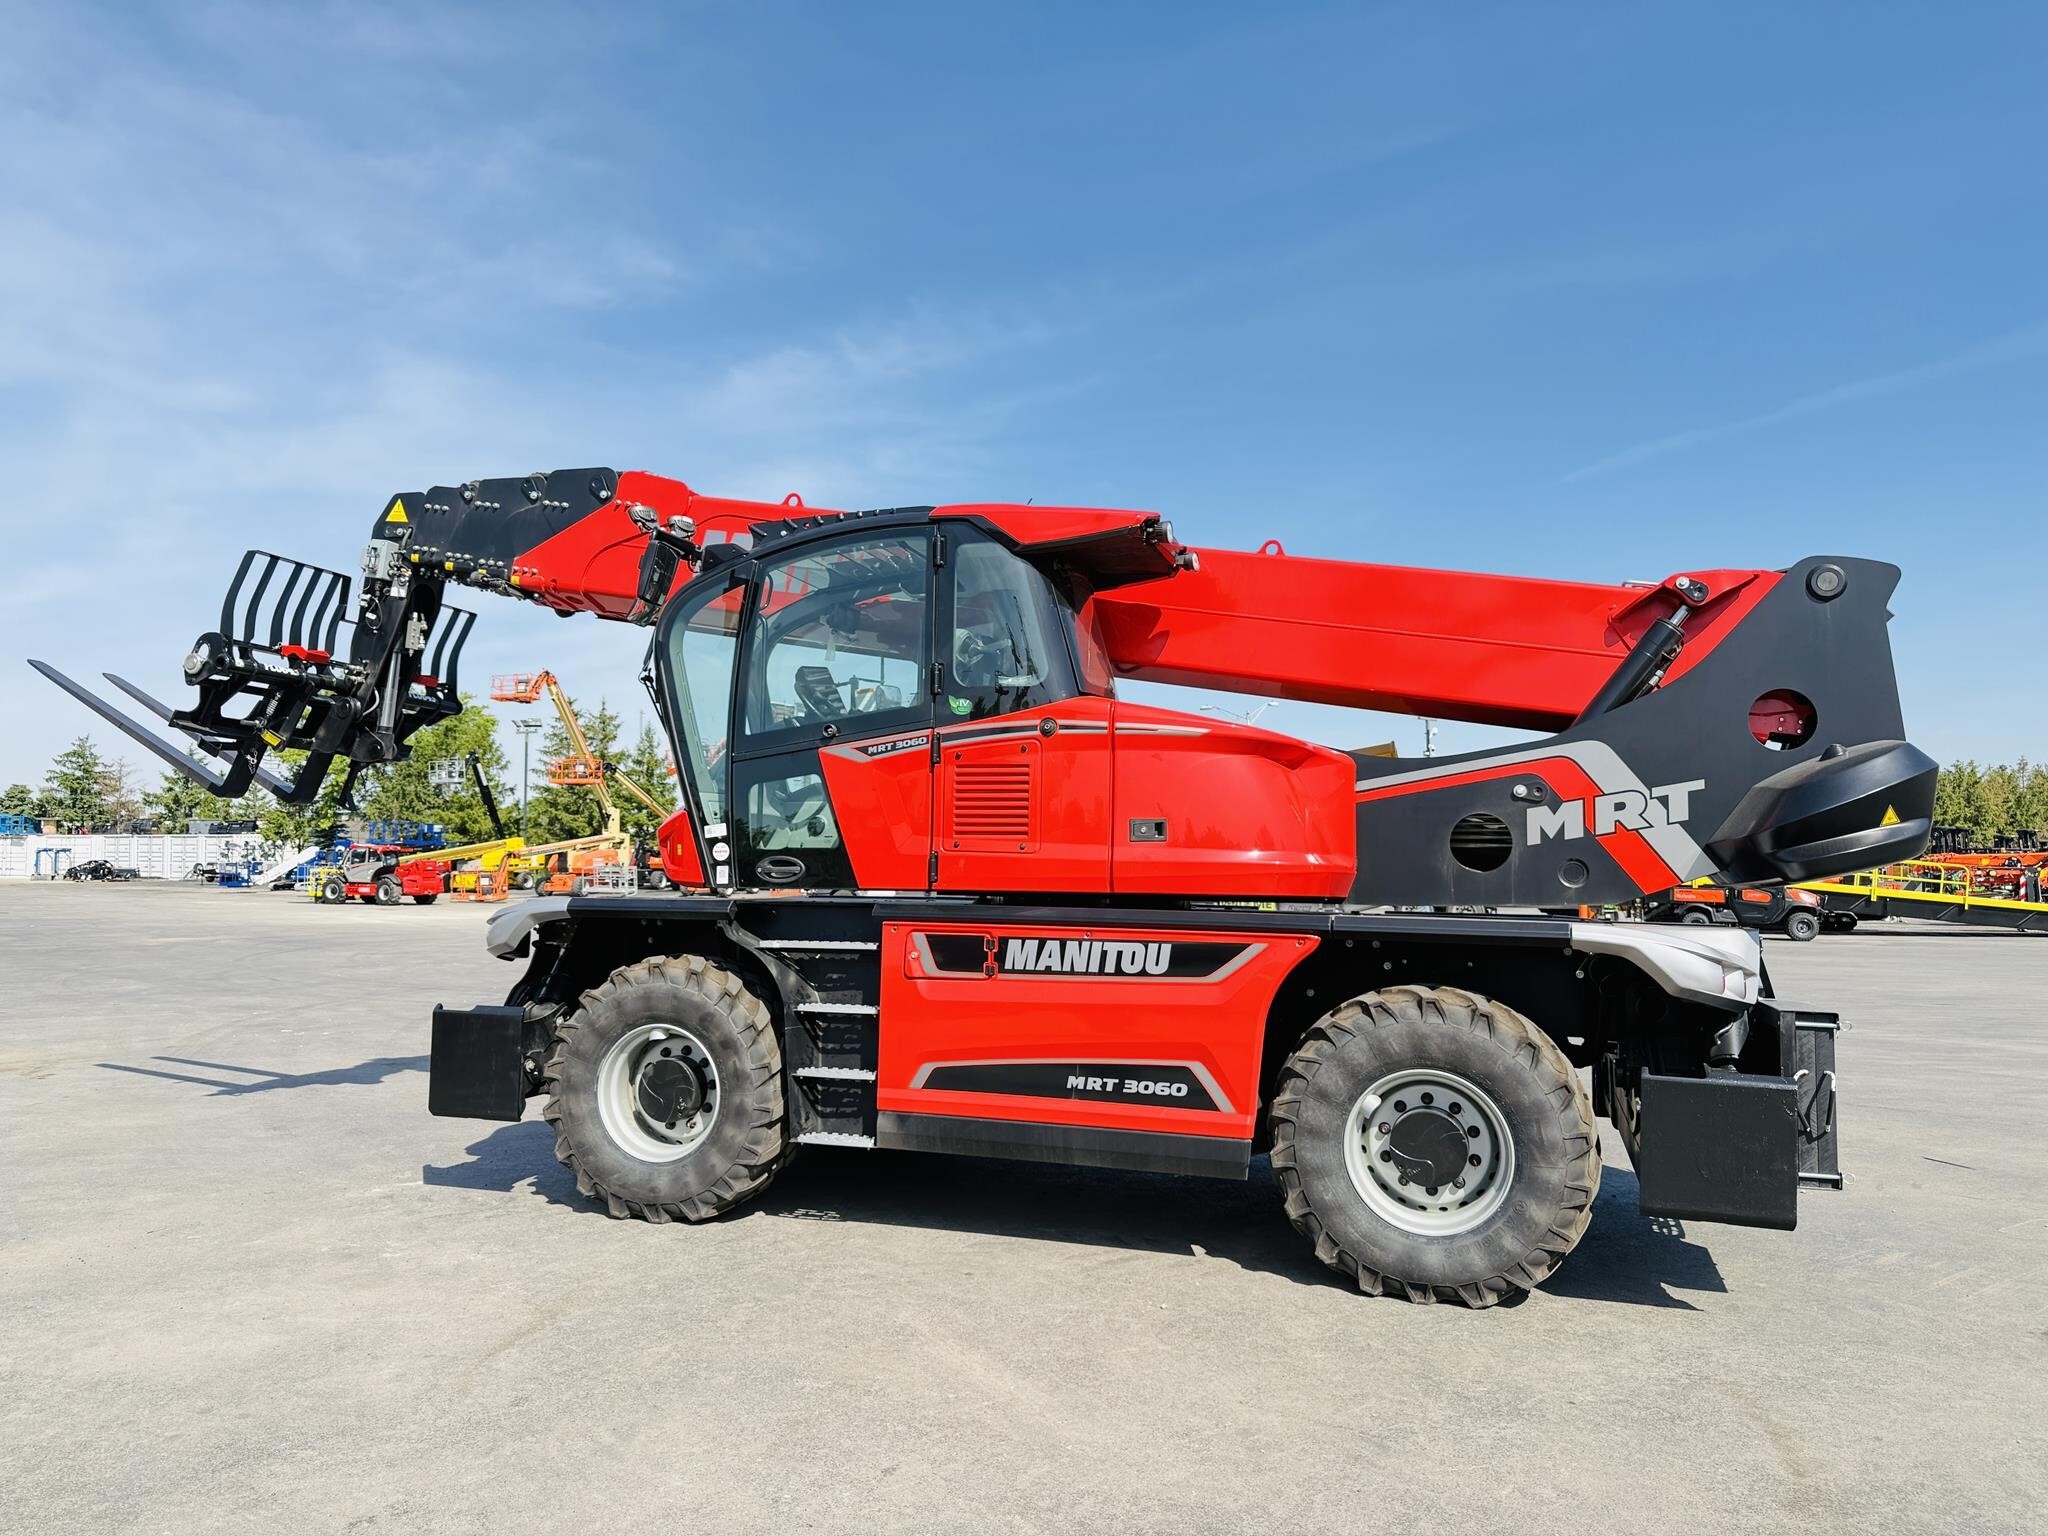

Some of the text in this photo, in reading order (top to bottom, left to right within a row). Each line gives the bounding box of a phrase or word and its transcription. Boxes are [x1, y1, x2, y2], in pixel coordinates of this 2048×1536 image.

[868, 737, 927, 754] MRT 3060
[1526, 779, 1705, 846] MRT
[1004, 939, 1172, 975] MANITOU
[1066, 1075, 1188, 1097] MRT 3060
